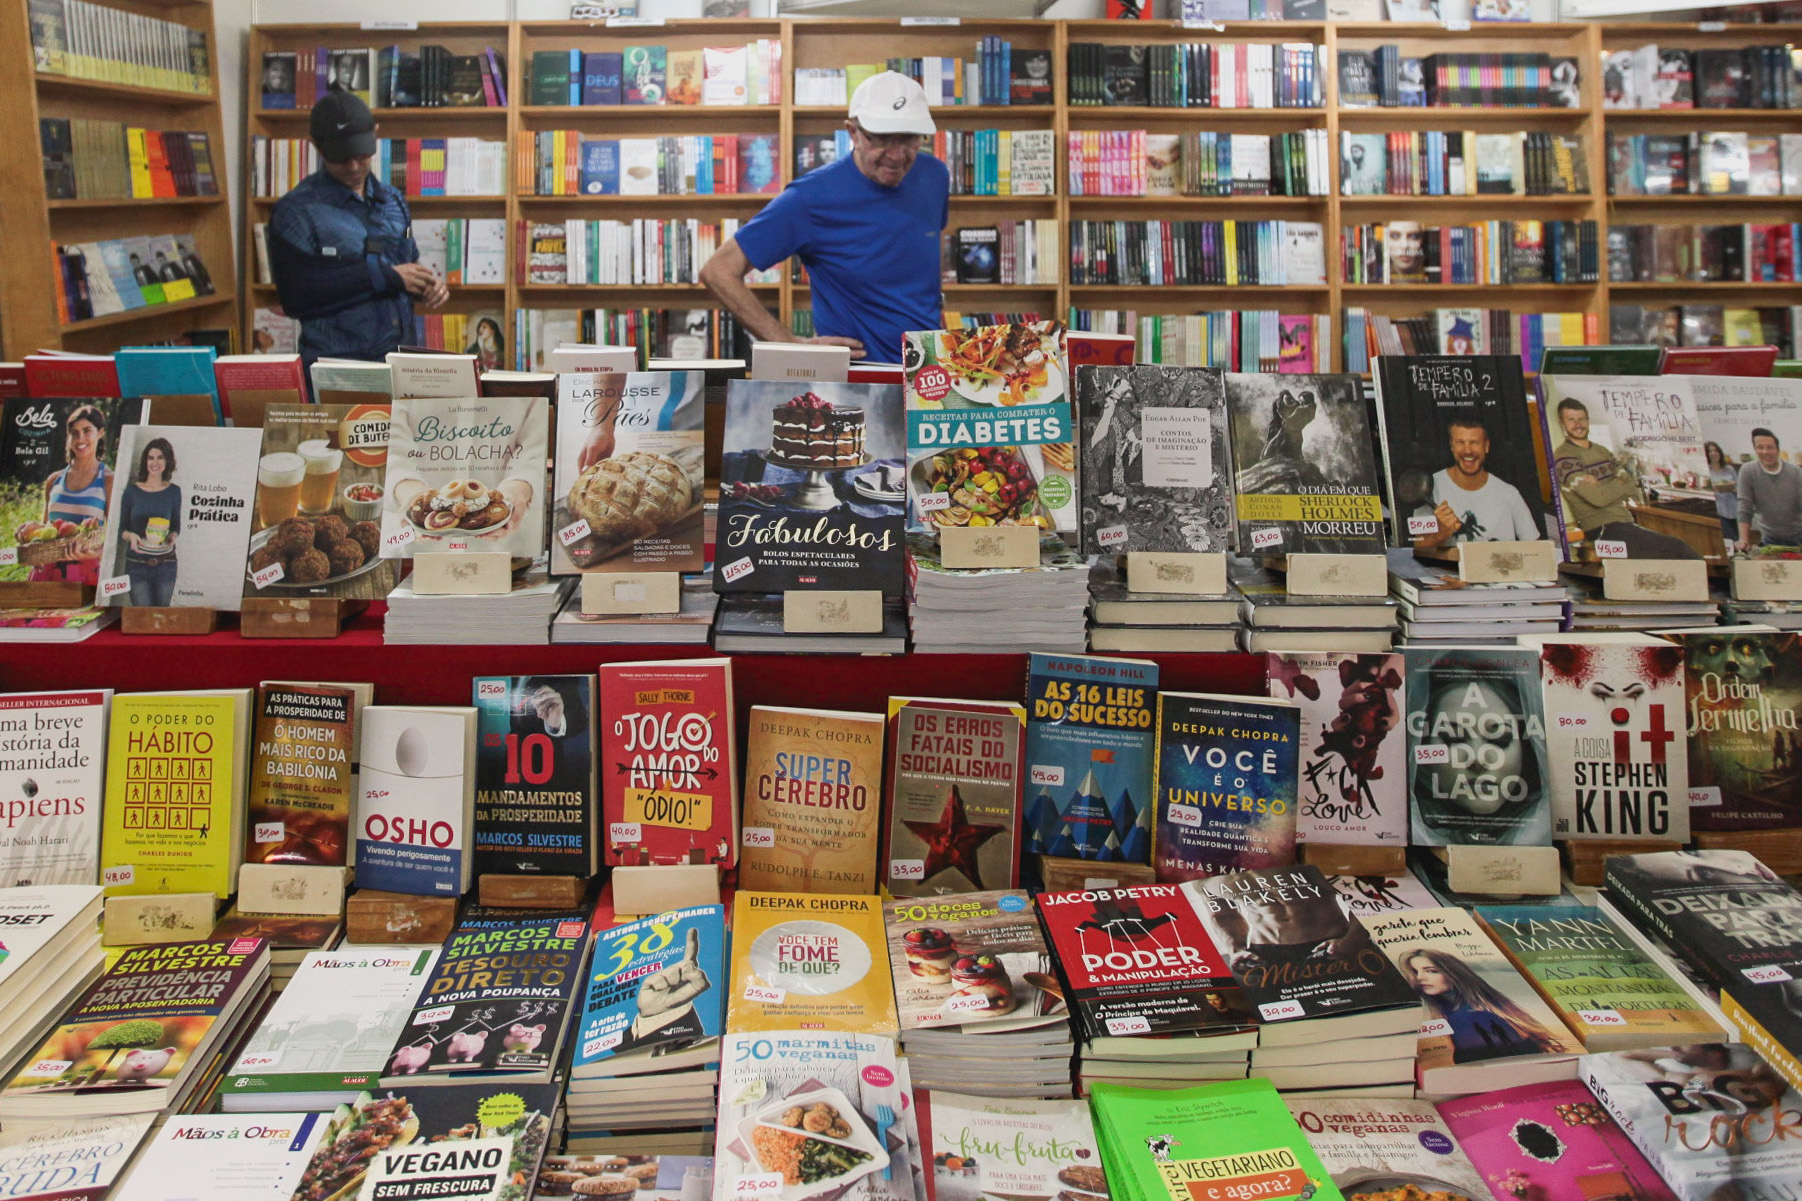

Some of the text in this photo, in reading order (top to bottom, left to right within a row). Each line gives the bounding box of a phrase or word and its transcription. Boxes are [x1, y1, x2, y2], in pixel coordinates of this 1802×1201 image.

[919, 374, 946, 388] 100
[1408, 364, 1473, 384] TEMPERO
[572, 387, 661, 399] LAROUSSE
[1431, 380, 1480, 399] FAMÍLIA
[1600, 389, 1682, 411] TEMPERO
[15, 403, 57, 428] Bela
[582, 397, 650, 428] Pães
[922, 408, 1047, 422] RECEITAS PARA COMBATER
[1628, 407, 1694, 432] FAMÍLIA
[413, 416, 515, 443] Biscoito
[918, 417, 1061, 445] DIABETES
[35, 446, 49, 455] Gil
[429, 444, 523, 461] BOLACHA?
[193, 483, 227, 493] Rita Lobo
[190, 494, 245, 508] Cozinha
[1299, 496, 1372, 507] SHERLOCK
[189, 508, 239, 522] Prática
[1301, 507, 1374, 520] HOLMES
[728, 514, 896, 551] Fabulosos
[1254, 532, 1279, 543] 63,00
[1303, 521, 1376, 535] MORREU
[763, 550, 856, 560] BOLOS ESPETACULARES
[1597, 543, 1625, 554] 45,00
[758, 558, 807, 567] PARA TODAS
[1047, 661, 1146, 679] NAPOLEON HILL
[1044, 681, 1145, 707] AS 16 LEIS
[1461, 682, 1488, 709] A
[1701, 672, 1761, 703] Ordem
[25, 697, 90, 708] INTERNACIONAL
[282, 693, 342, 708] PRÁTICAS PARA
[35, 712, 84, 730] breve
[147, 714, 215, 726] PODER DO
[273, 707, 333, 720] PROSPERIDADE
[1034, 699, 1151, 728] DO SUCESSO
[288, 726, 335, 742] HOMEM
[622, 712, 713, 751] JOGO
[761, 722, 872, 744] DEEPAK CHOPRA
[914, 714, 1004, 738] OS ERROS
[1172, 722, 1289, 743] DEEPAK CHOPRA
[1407, 711, 1546, 740] GAROTA
[58, 730, 80, 749] da
[128, 726, 214, 754] HÁBITO
[911, 734, 1005, 759] FATAIS DO
[260, 742, 346, 763] MAIS RICO DA
[504, 733, 554, 785] 10
[1182, 744, 1278, 774] VOCÊ
[1451, 744, 1506, 771] DO
[266, 760, 338, 780] BABILÔNIA
[630, 753, 702, 789] AMOR
[774, 752, 852, 785] SUPER
[900, 753, 1012, 780] SOCIALISMO
[1032, 770, 1058, 782] 45,00
[1574, 761, 1668, 787] STEPHEN
[477, 790, 582, 806] MANDAMENTOS
[758, 771, 867, 811] CÉREBRO
[1431, 773, 1529, 802] LAGO
[0, 795, 85, 828] apiens
[1168, 788, 1287, 815] UNIVERSO
[1575, 789, 1669, 835] KING
[491, 809, 582, 823] PROSPERIDADE
[12, 835, 68, 847] Noah Harari
[365, 814, 454, 849] OSHO
[477, 832, 582, 847] MARCOS SILVESTRE
[612, 827, 636, 836] 40,00
[787, 822, 867, 839] TRANSFORMADOR
[366, 846, 451, 863] Vivendo perigosamente
[750, 861, 865, 883] RUDOLPH TANZI
[1202, 872, 1308, 898] LAUREN
[750, 896, 869, 911] DEEPAK CHOPRA
[1045, 885, 1177, 907] JACOB PETRY
[1206, 886, 1323, 913] BLAKELY
[894, 902, 982, 922] 50 doces
[929, 908, 998, 922] veganos
[603, 907, 716, 941] ARTHUR SCHOPENHAUER
[1373, 916, 1445, 936] garota que
[1496, 918, 1615, 936] YANN
[452, 927, 551, 947] MARCOS
[594, 911, 681, 981] 38
[1377, 926, 1473, 948] queria lembrar
[1516, 936, 1634, 952] MARTEL
[124, 942, 226, 963] MARCOS
[447, 938, 577, 960] SILVESTRE
[778, 945, 840, 962] FOME
[1081, 946, 1204, 972] PODER
[114, 954, 247, 976] SILVESTRE
[440, 953, 571, 976] TESOURO
[616, 961, 662, 984] VENCER
[1102, 965, 1211, 983] MANIPULAÇÃO
[98, 969, 232, 992] PREVIDÊNCIA
[430, 968, 565, 995] DIRETO
[1747, 970, 1784, 981] 45,00
[86, 983, 225, 1006] PARTICULAR
[122, 998, 215, 1010] APOSENTADORIA
[437, 986, 561, 1003] NOVA POUPANÇA
[588, 988, 637, 1013] DEBATE
[735, 1039, 876, 1062] 50 marmitas
[777, 1051, 858, 1063] veganas
[1323, 1112, 1436, 1124] comidinhas
[1450, 1101, 1506, 1119] Virginia Woolf
[171, 1126, 291, 1140] Mãos Obra
[384, 1147, 502, 1175] VEGANO
[1178, 1150, 1296, 1181] VEGETARIANO
[376, 1179, 491, 1198] SEM FRESCURA
[1227, 1173, 1293, 1200] agora?
